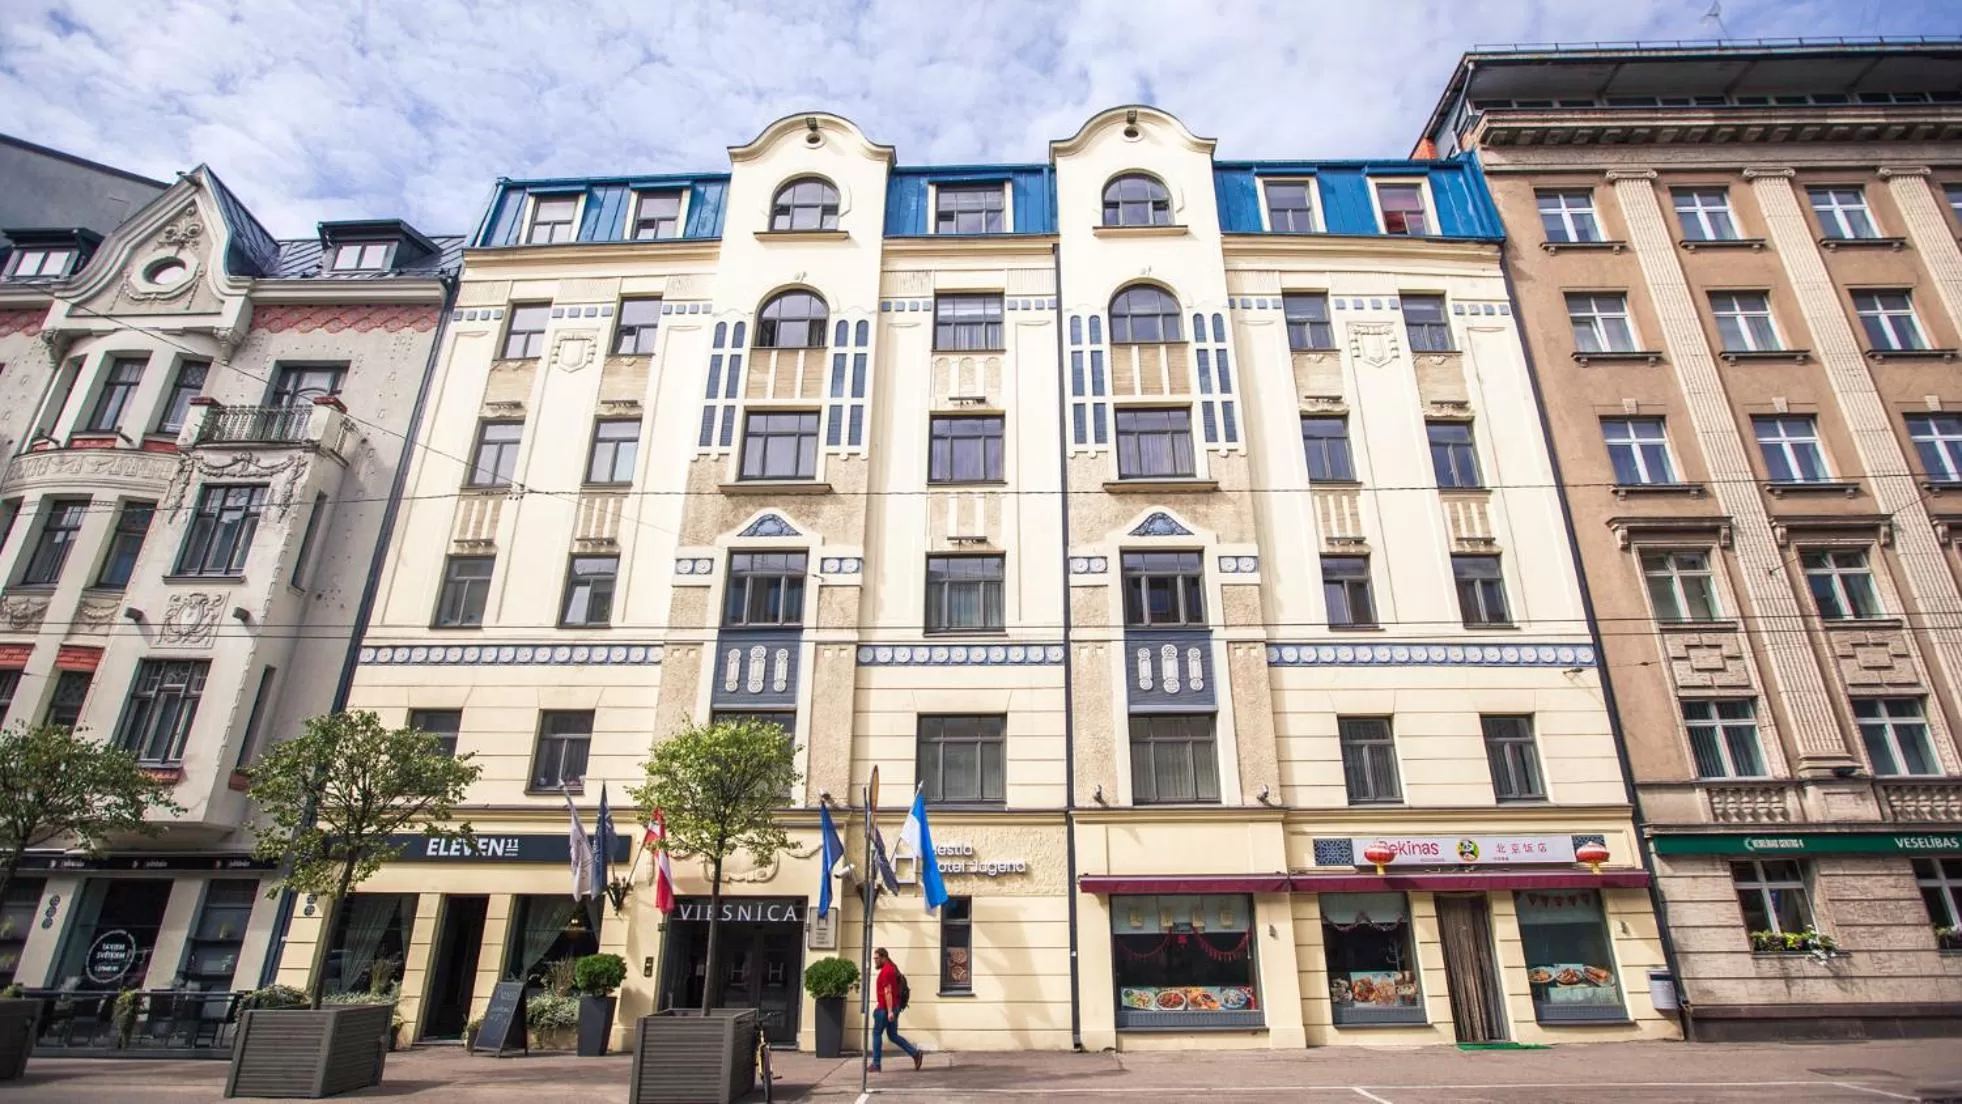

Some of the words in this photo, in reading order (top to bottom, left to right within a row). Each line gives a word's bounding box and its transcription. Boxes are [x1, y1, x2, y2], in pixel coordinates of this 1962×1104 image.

[426, 837, 505, 856] ELEVEN
[934, 842, 973, 855] estia
[1894, 835, 1960, 848] VESELĪBAS
[936, 859, 965, 873] otel
[680, 902, 798, 921] VIESNĪCA
